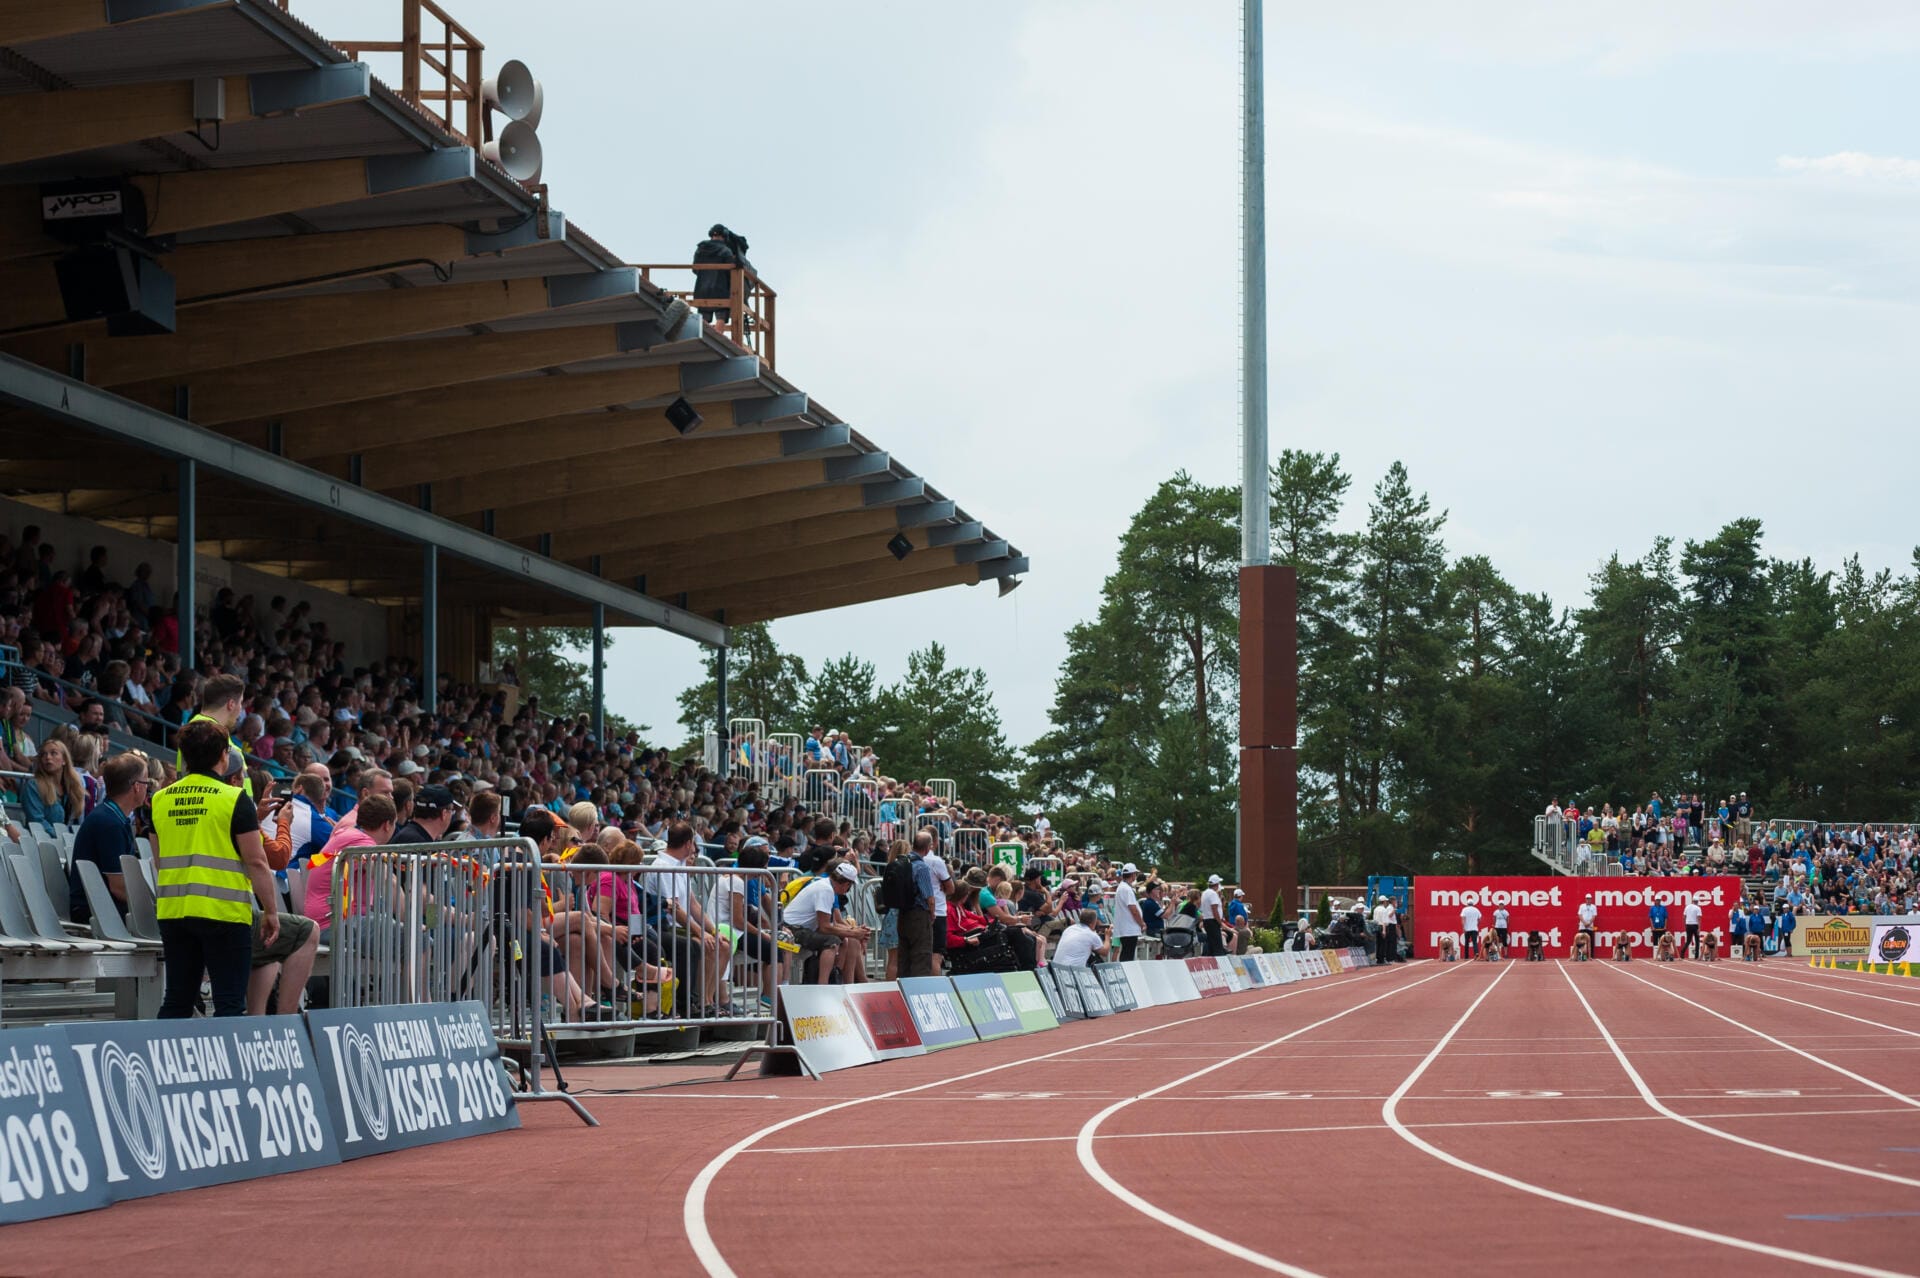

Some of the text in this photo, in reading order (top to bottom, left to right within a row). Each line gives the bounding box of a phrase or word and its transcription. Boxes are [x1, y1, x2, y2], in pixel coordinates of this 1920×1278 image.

[61, 386, 70, 410] A
[1431, 885, 1562, 907] motonet
[1594, 885, 1724, 907] motonet
[1808, 930, 1868, 942] PANCHO VILLA
[373, 1012, 488, 1062] KALEVAN Jyväskylä
[147, 1027, 304, 1086] KALEVAN Jyväskylä
[385, 1058, 507, 1134] KISAT 2018
[161, 1082, 323, 1171] KISAT 2018
